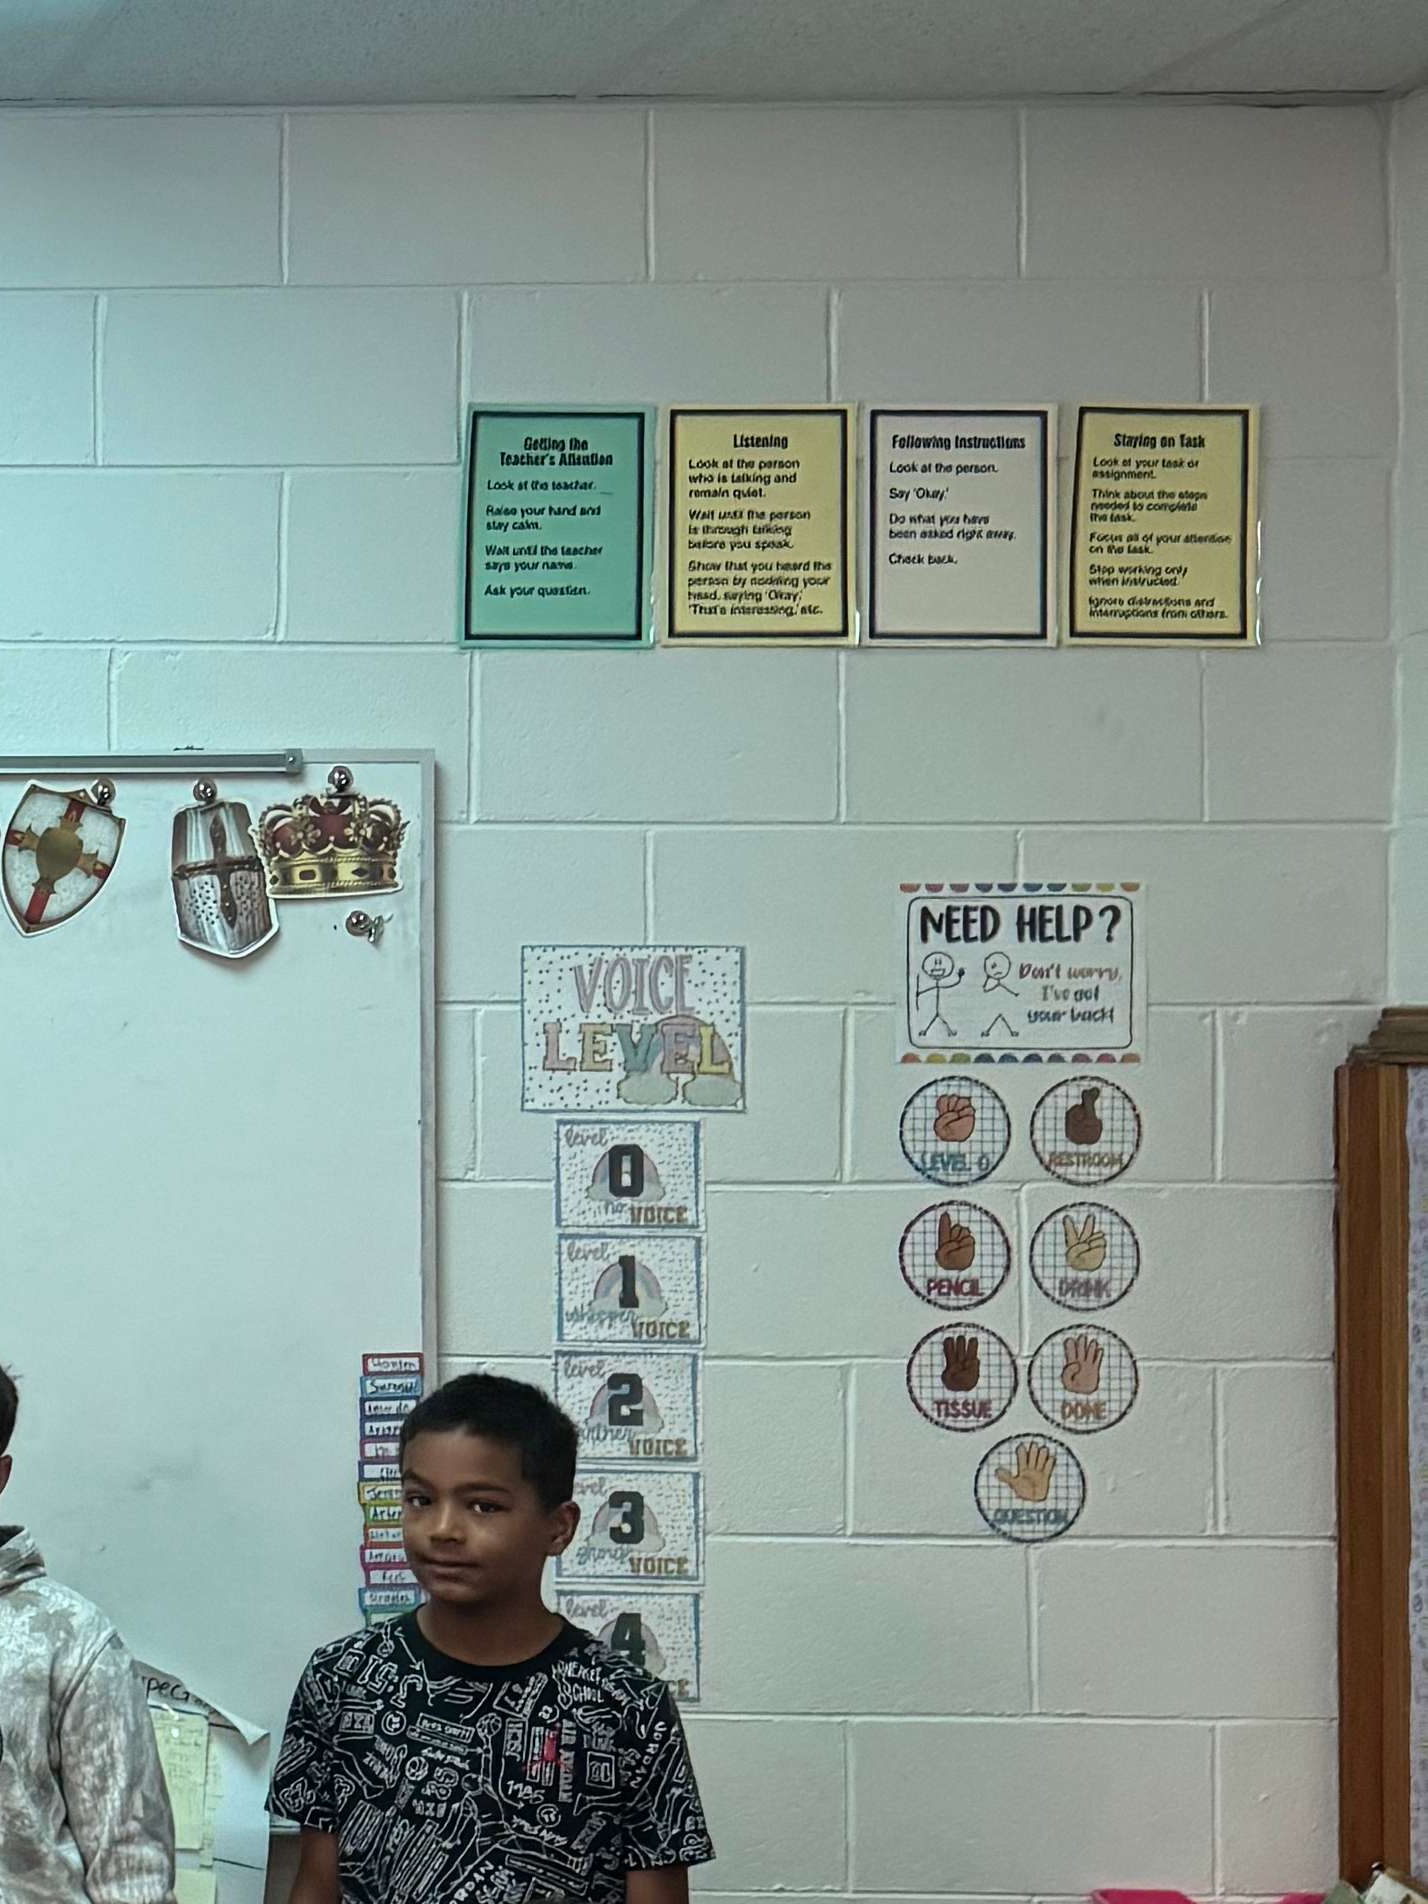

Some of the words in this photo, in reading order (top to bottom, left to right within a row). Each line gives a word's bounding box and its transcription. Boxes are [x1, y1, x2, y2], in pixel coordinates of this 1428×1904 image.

[733, 434, 788, 450] Listening
[892, 434, 951, 450] Following
[954, 435, 1026, 450] Instructions
[1113, 433, 1157, 450] Staying
[1160, 436, 1176, 448] on
[1179, 434, 1206, 448] Task
[688, 458, 719, 469] Look
[758, 459, 801, 471] person
[774, 472, 797, 484] and
[920, 905, 1001, 944] NEED
[1016, 904, 1122, 944] HELP?
[1019, 963, 1061, 980] Don't
[573, 952, 694, 1016] VOICE
[1074, 985, 1100, 1003] got
[542, 1021, 733, 1077] LEVEL
[564, 1125, 609, 1147] level
[919, 1152, 971, 1172] LEVEL
[1047, 1152, 1125, 1169] RESTROOM
[608, 1144, 644, 1198] 0
[629, 1206, 688, 1225] VOICE
[567, 1240, 610, 1262] level
[618, 1255, 639, 1309] 1
[926, 1279, 985, 1297] PENCIL
[631, 1321, 691, 1339] VOICE
[564, 1356, 606, 1378] level
[607, 1372, 644, 1427] 2
[933, 1399, 993, 1419] TISSUE
[1061, 1400, 1107, 1421] DONE
[576, 1422, 633, 1444] artner
[629, 1438, 689, 1457] VOICE
[608, 1490, 645, 1545] 3
[994, 1508, 1070, 1526] QUESTION
[629, 1556, 689, 1575] VOICE
[611, 1612, 646, 1665] 4
